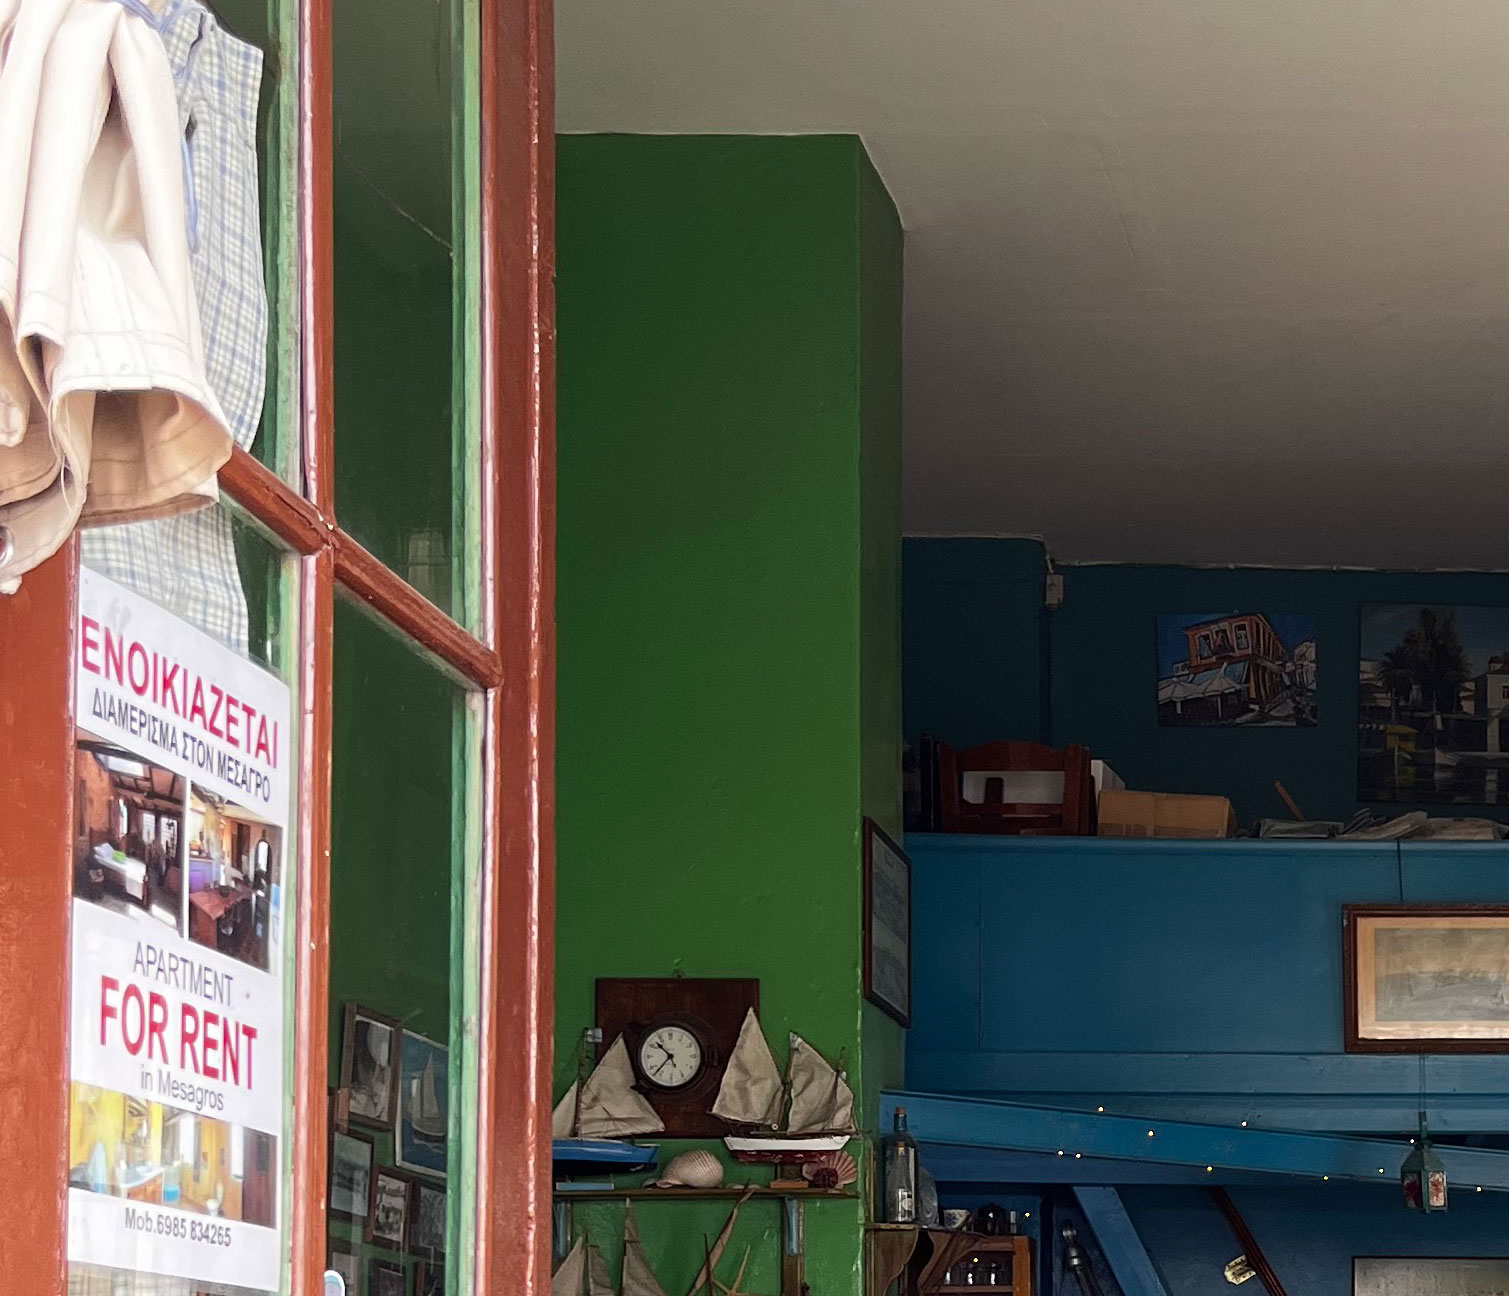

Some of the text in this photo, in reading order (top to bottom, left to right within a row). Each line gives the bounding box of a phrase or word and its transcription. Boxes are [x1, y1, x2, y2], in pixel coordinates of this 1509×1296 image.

[81, 615, 279, 769] ΕΝΟΙΚΙΑΖΕΤΑΙ
[92, 687, 271, 803] ΔΙΑΜΕΡΙΣΜΑ ΣΤΟΝ ΜΕΣΑΓΡΟ
[133, 940, 234, 1007] APARTMENT
[100, 974, 258, 1090] FOR RENT
[140, 1064, 225, 1111] in Mesagros
[189, 1220, 232, 1248] 834265
